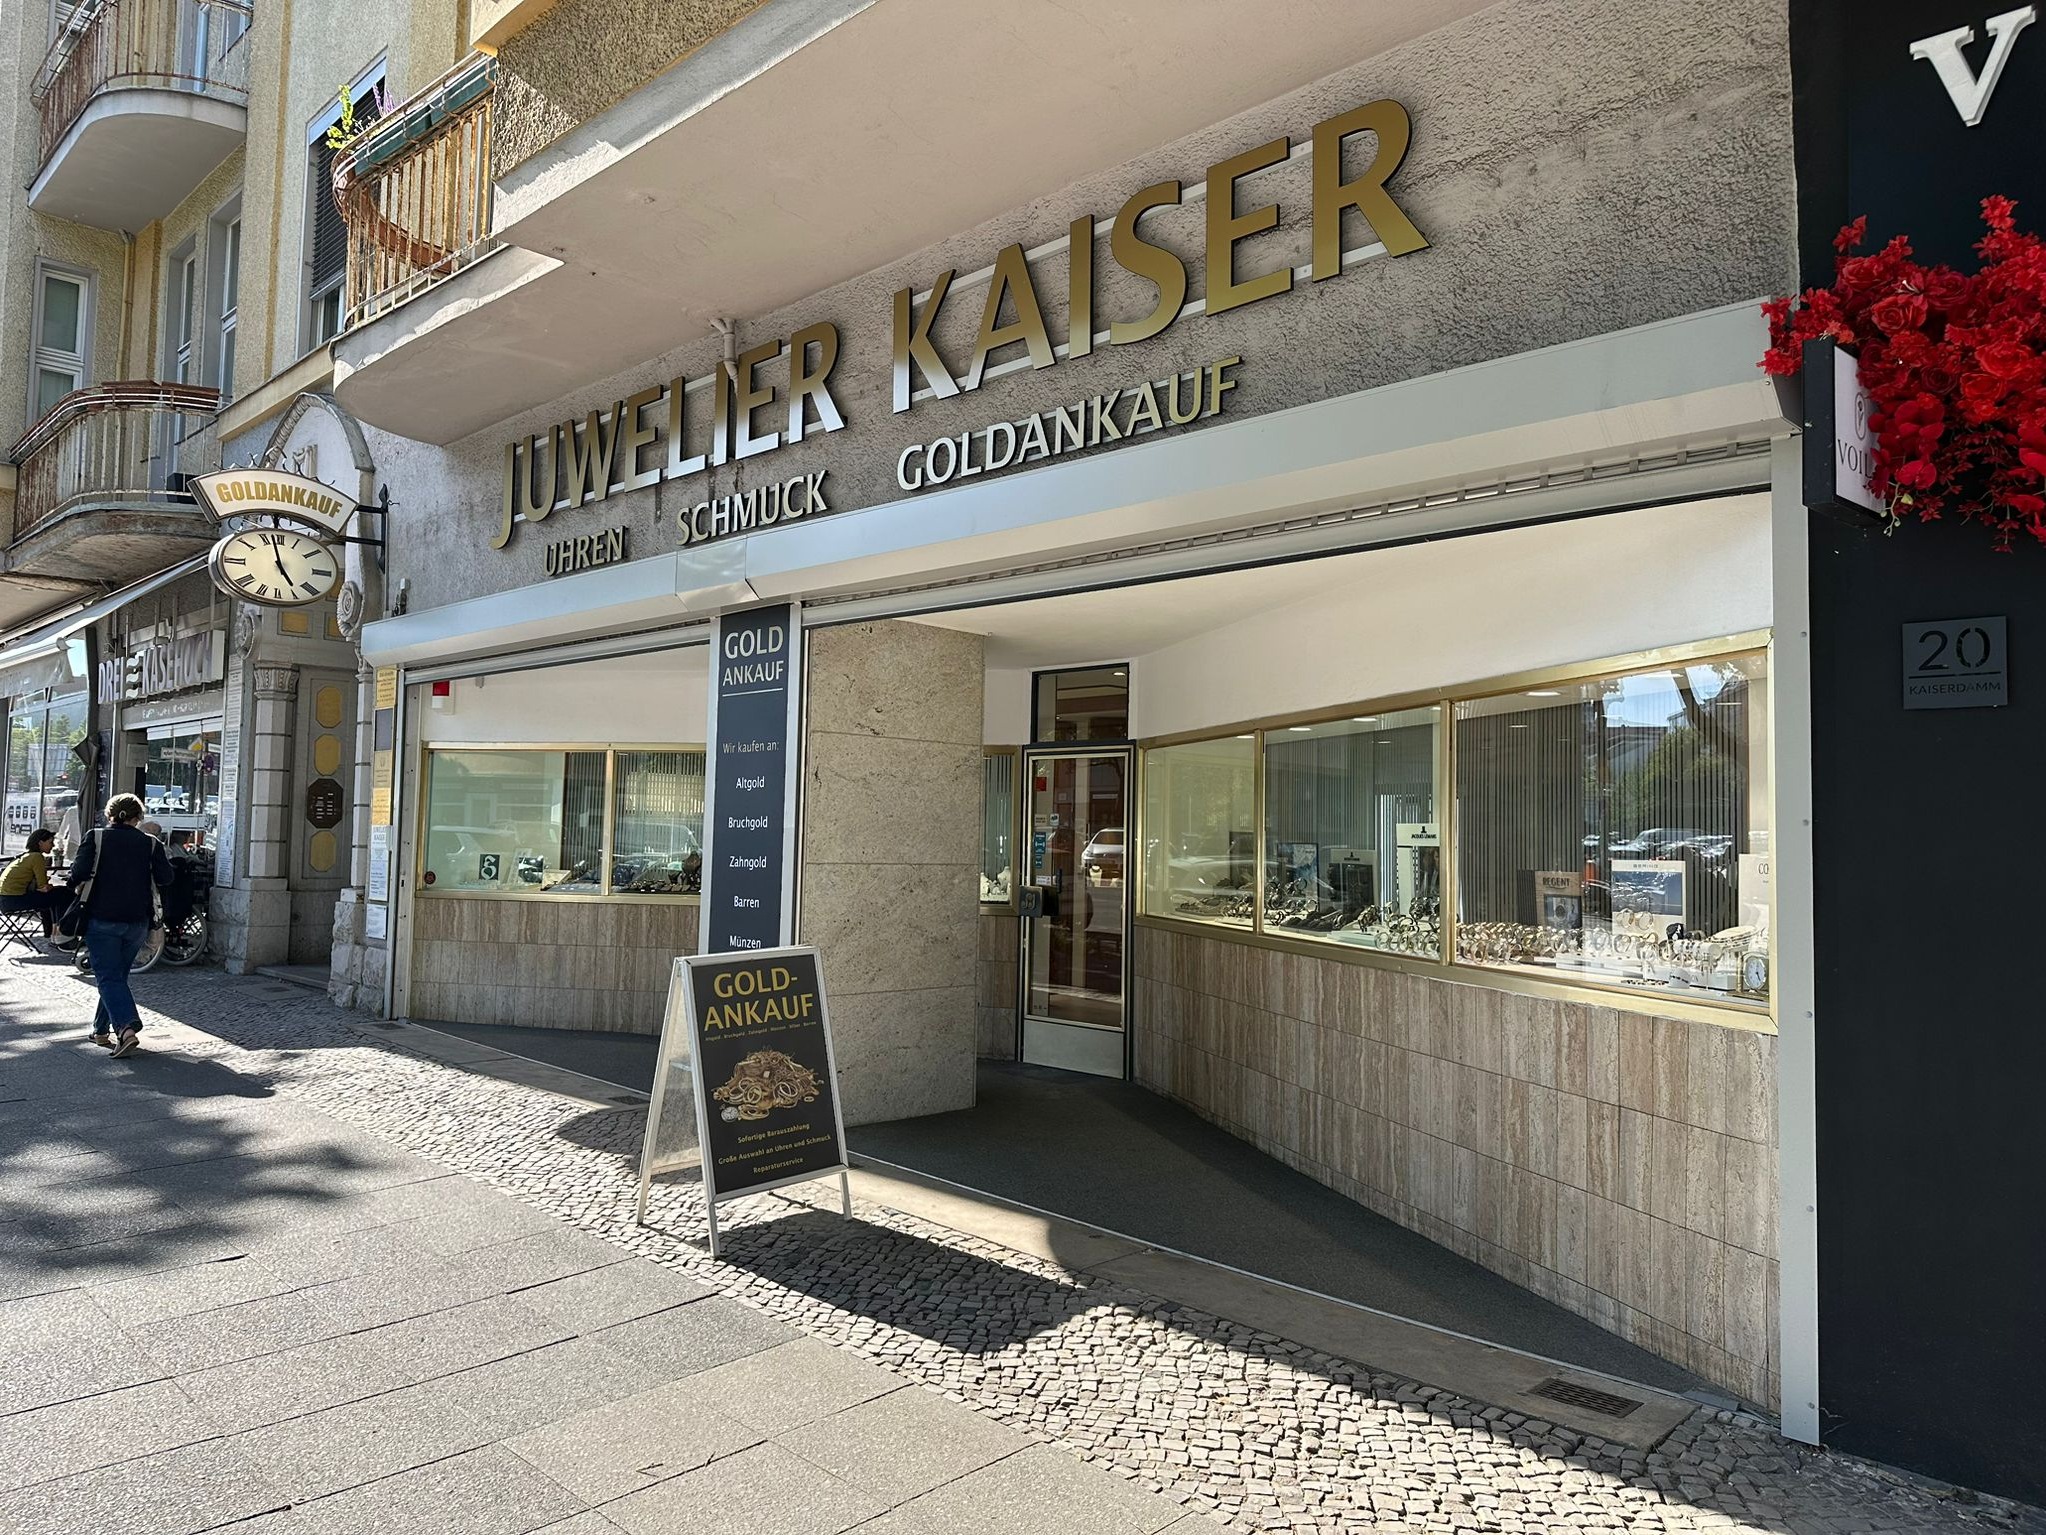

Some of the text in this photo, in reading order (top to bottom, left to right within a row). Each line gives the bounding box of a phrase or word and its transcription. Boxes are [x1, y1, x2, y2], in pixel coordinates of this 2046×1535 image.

[1909, 5, 2036, 127] V
[489, 98, 1431, 550] JUWELIER KAISER
[544, 355, 1242, 577] UHREN SCHMUCK GOLDANKAUF
[1837, 439, 1873, 479] VOIL
[216, 481, 343, 518] GOLDANKAUF
[724, 625, 784, 659] GOLD
[1919, 627, 1990, 671] 20
[98, 656, 124, 705] DREI
[723, 660, 784, 687] ANKAUF
[1909, 682, 2001, 695] KAISERDAMM
[722, 740, 780, 754] Wir kaufen an:
[736, 776, 765, 791] Altgold
[728, 816, 768, 831] Bruchgold
[729, 855, 767, 871] Zahngold
[733, 895, 760, 909] Barren
[729, 935, 761, 949] Münzen
[713, 967, 798, 998] GOLD-
[704, 993, 813, 1031] ANKAUF
[738, 1123, 810, 1143] Sofortige Barauszahlung
[718, 1155, 737, 1165] Große
[738, 1149, 765, 1160] Auswahl
[775, 1143, 793, 1152] Uhren
[794, 1139, 805, 1147] und
[806, 1134, 832, 1145] Schmuck
[753, 1157, 804, 1174] Reparaturservice
